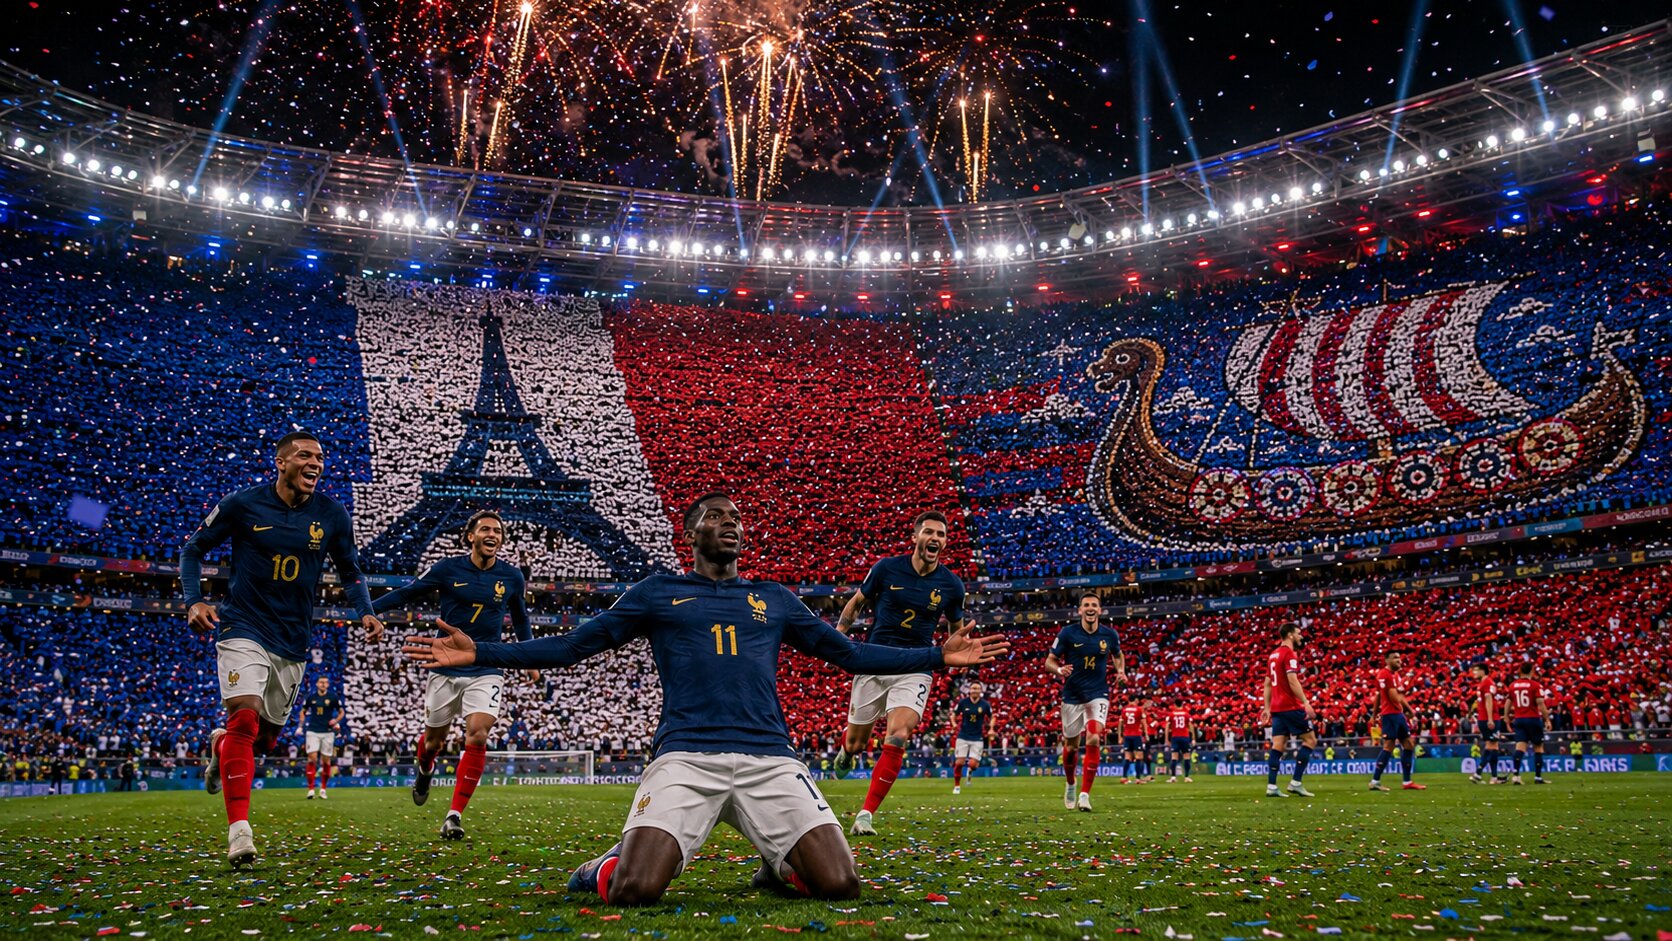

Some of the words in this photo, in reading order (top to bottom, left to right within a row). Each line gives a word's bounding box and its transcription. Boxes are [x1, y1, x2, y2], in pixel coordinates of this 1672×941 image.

[272, 554, 300, 582] 10
[470, 603, 484, 624] 7
[900, 609, 916, 629] 2
[710, 623, 738, 656] 11
[1084, 656, 1096, 670] 14
[491, 685, 500, 703] 2
[917, 683, 927, 702] 2
[1514, 689, 1530, 708] 16
[795, 773, 819, 800] 1
